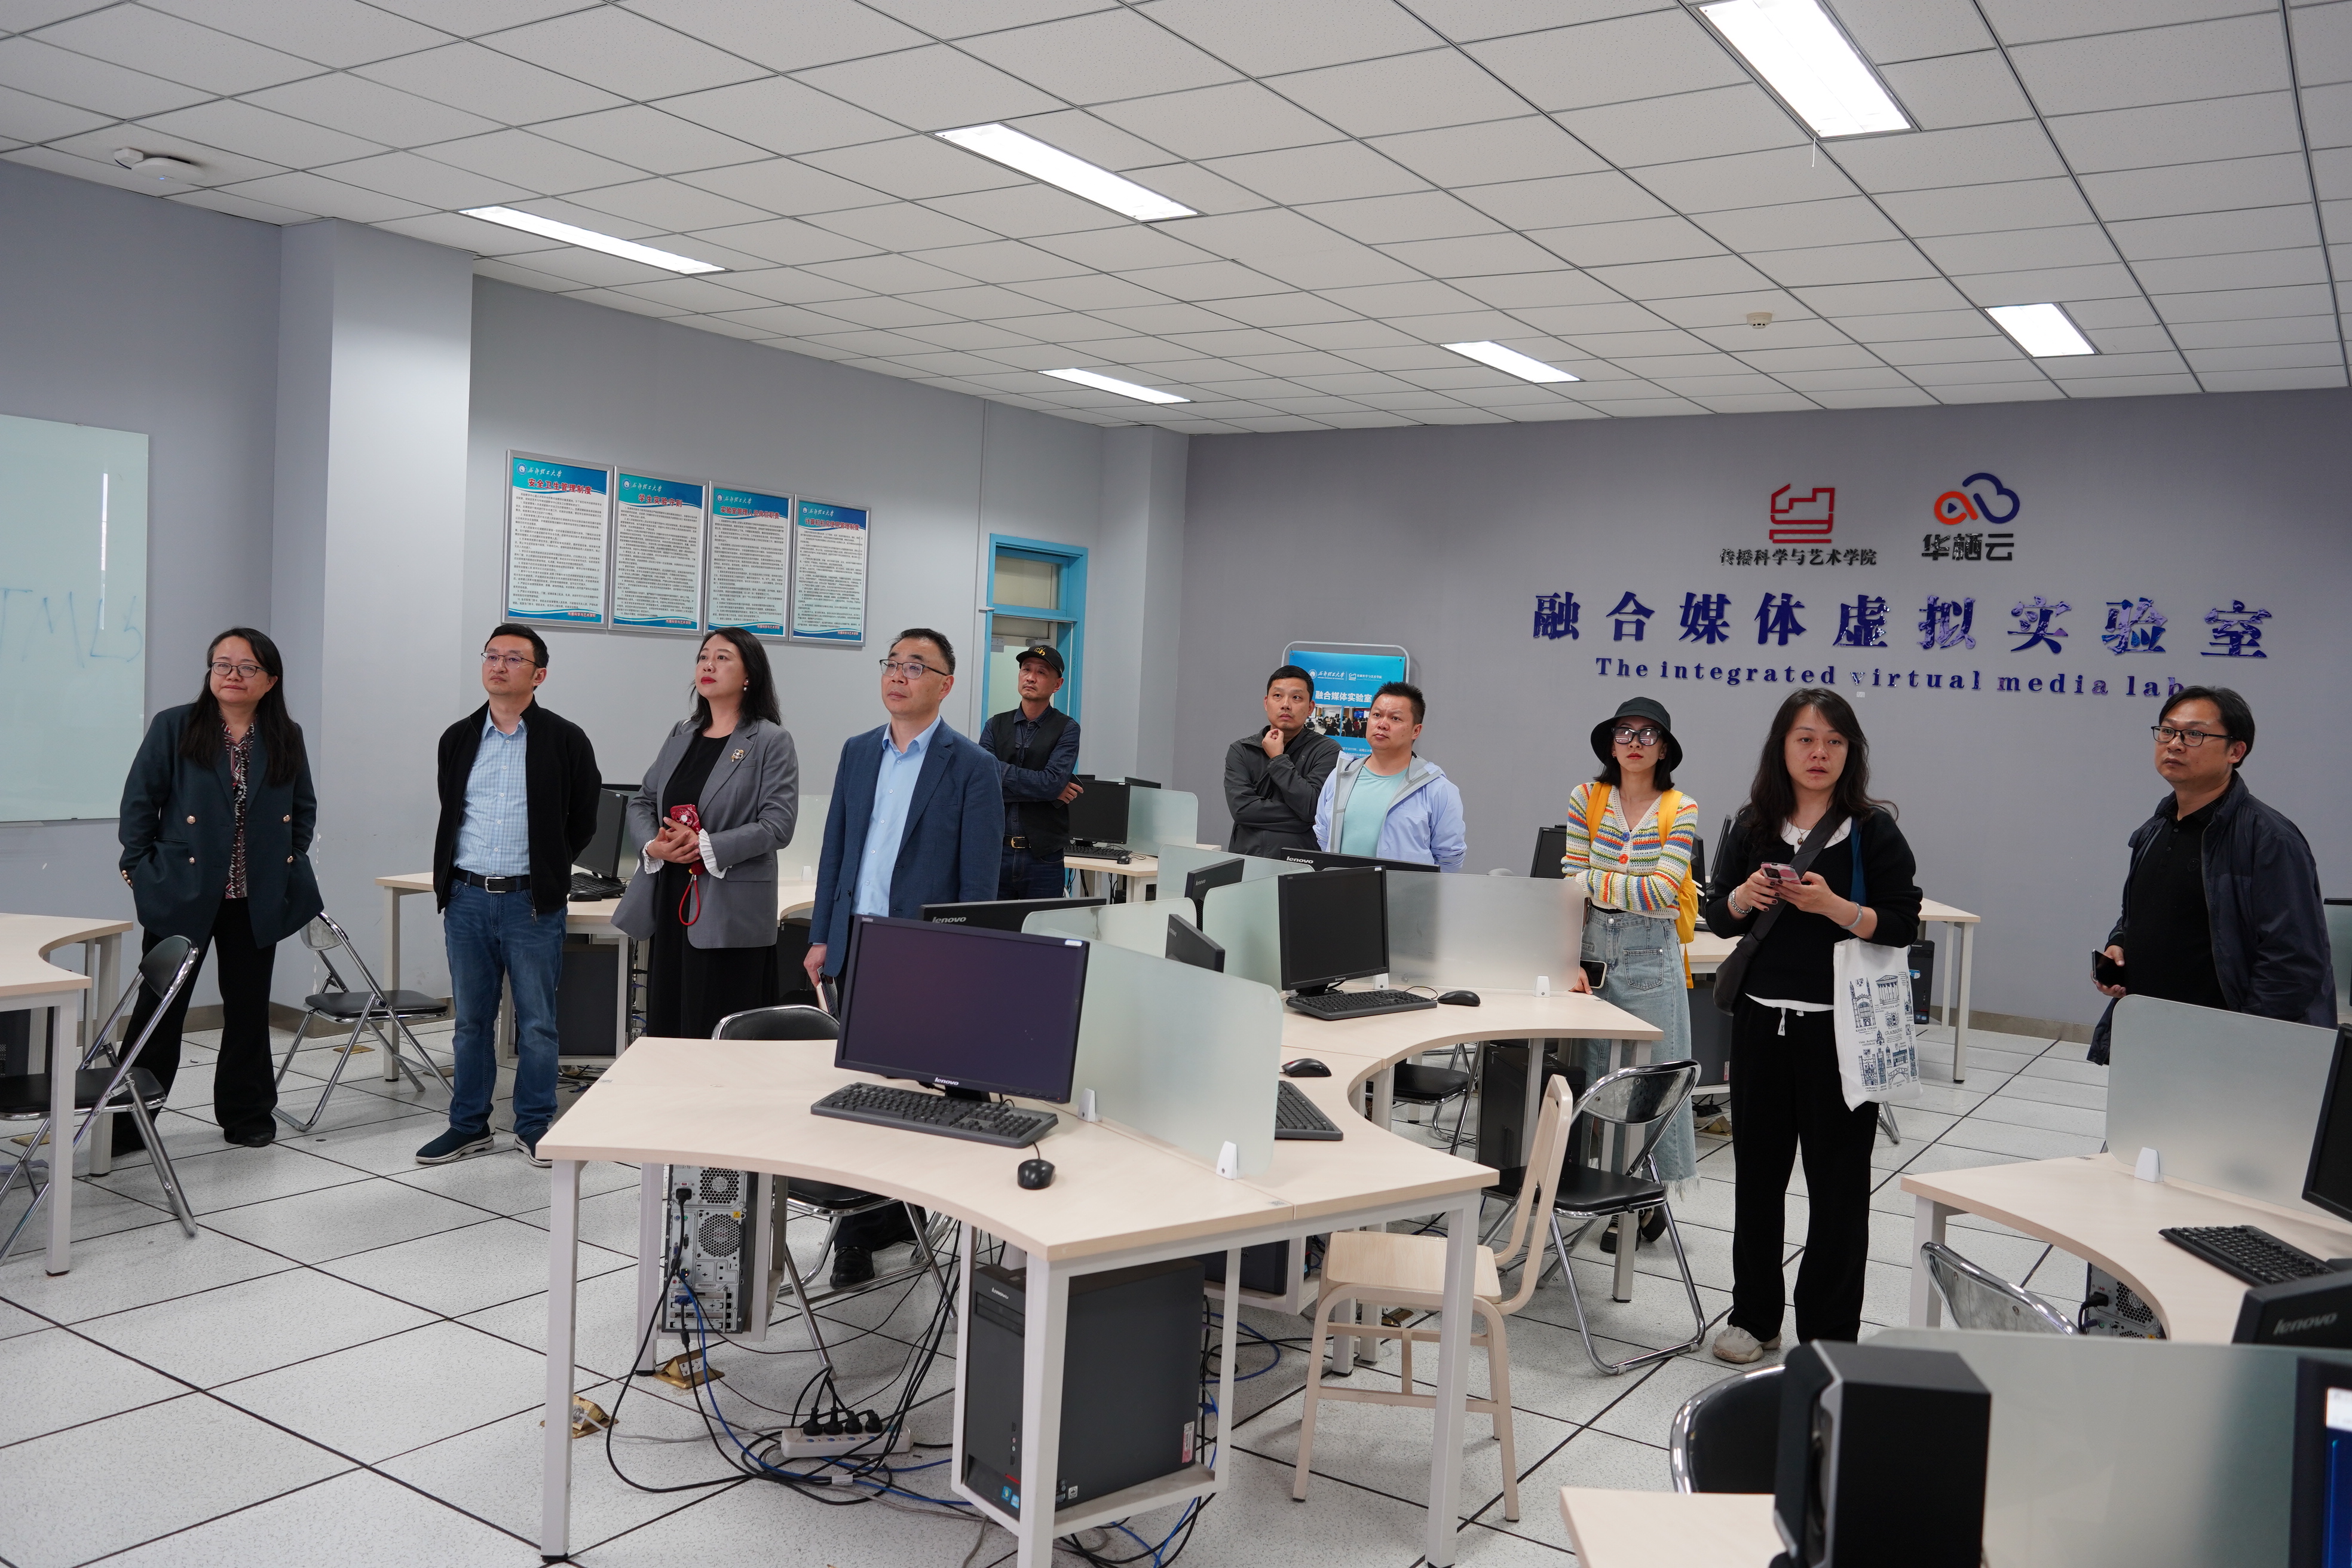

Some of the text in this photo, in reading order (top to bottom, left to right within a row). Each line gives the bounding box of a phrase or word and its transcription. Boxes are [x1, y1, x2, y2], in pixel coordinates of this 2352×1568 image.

[528, 478, 592, 495] 安全卫生管理制度
[638, 494, 682, 507] 学生实验守则
[721, 506, 780, 519] 实验室管理人员岗位职责
[805, 517, 860, 531] 计算机机房使用管理制度
[1922, 533, 2015, 561] 华栖云
[1719, 548, 1878, 566] 传播科学与艺术学院
[1533, 591, 2273, 659] 融合媒体虚拟实验室
[1596, 658, 2185, 697] The integrated virtual media lab
[1315, 690, 1373, 703] 融合媒体实验室
[1286, 856, 1314, 864] lenovo
[934, 1077, 959, 1086] lenovo
[991, 1287, 1009, 1300] lenovo
[2272, 1312, 2338, 1336] lenovo
